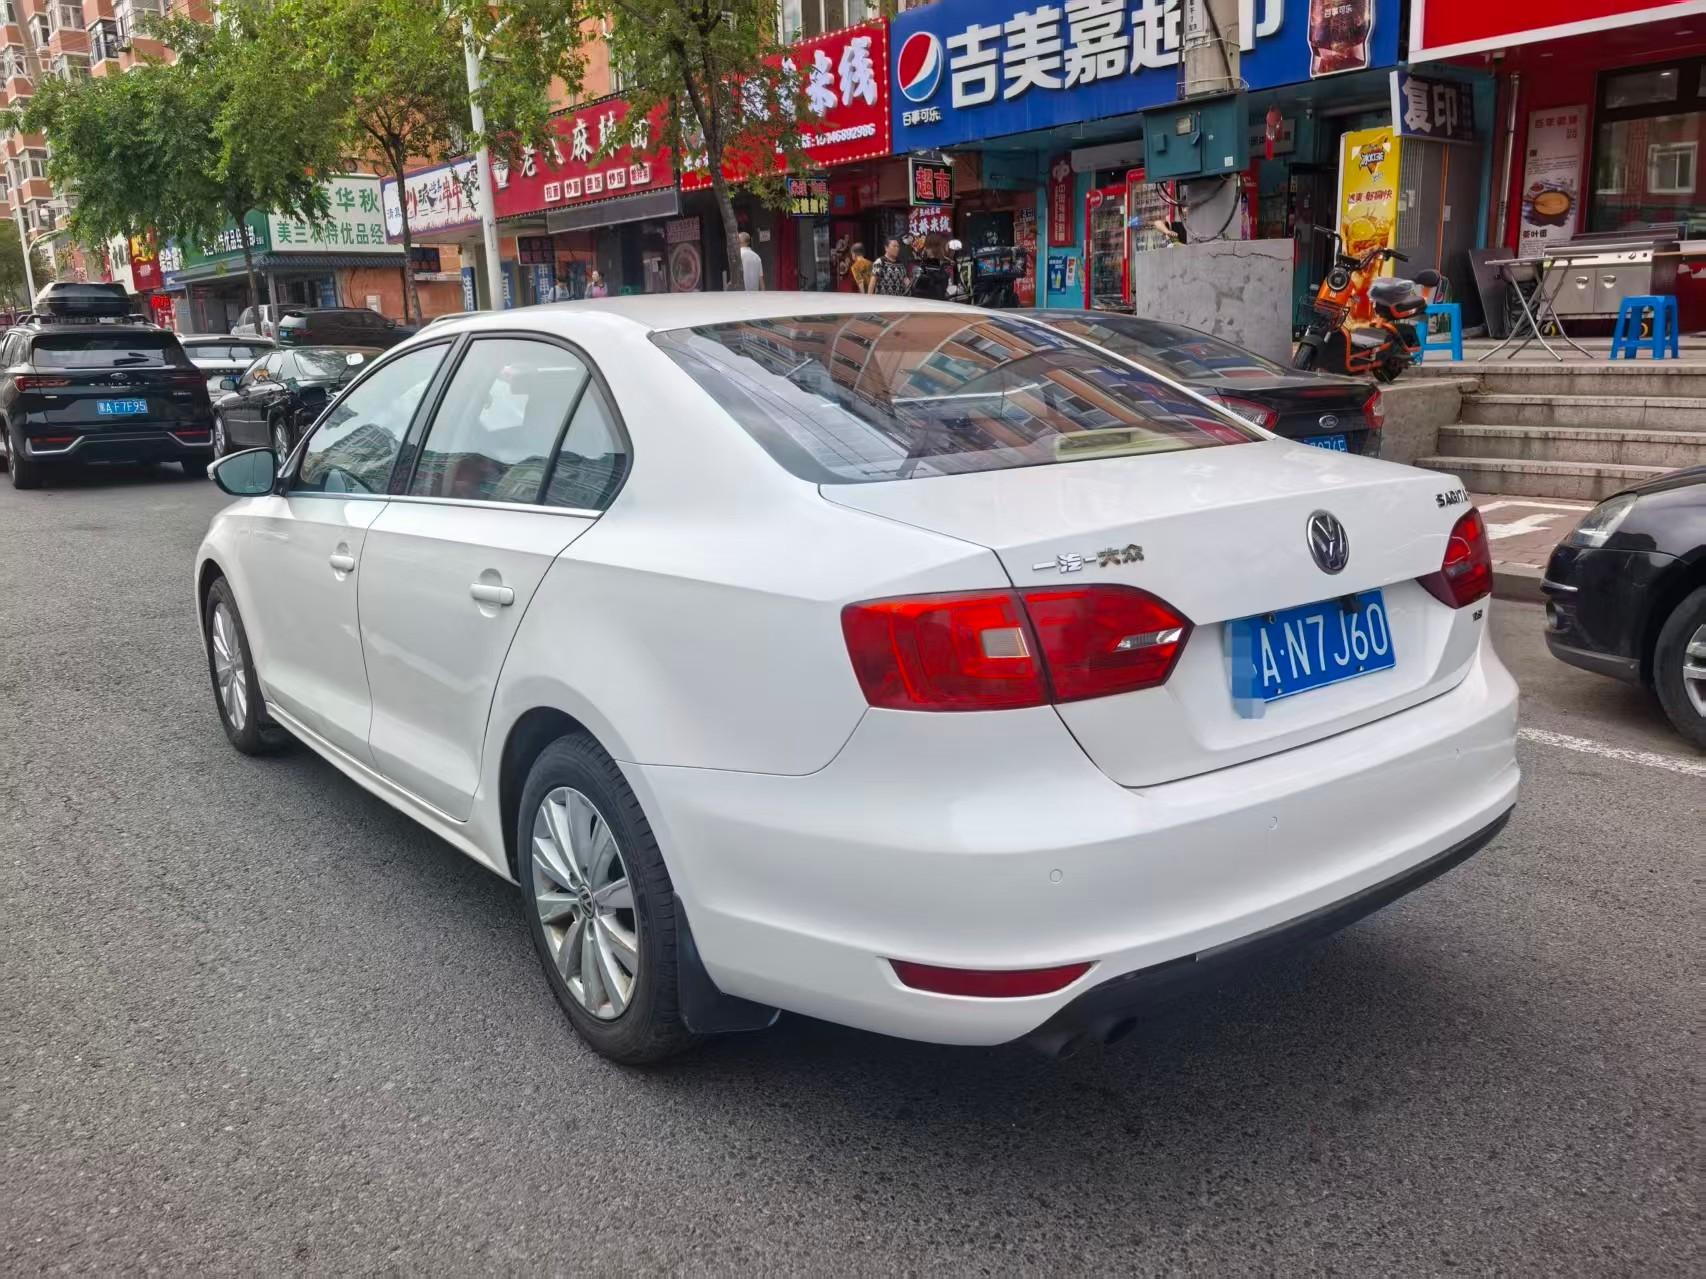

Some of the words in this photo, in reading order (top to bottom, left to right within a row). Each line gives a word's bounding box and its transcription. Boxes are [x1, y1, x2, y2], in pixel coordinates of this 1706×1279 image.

[902, 106, 942, 127] 百事可乐
[1402, 76, 1458, 136] 复印
[915, 165, 952, 201] 超市
[1252, 602, 1389, 687] A·N7J60
